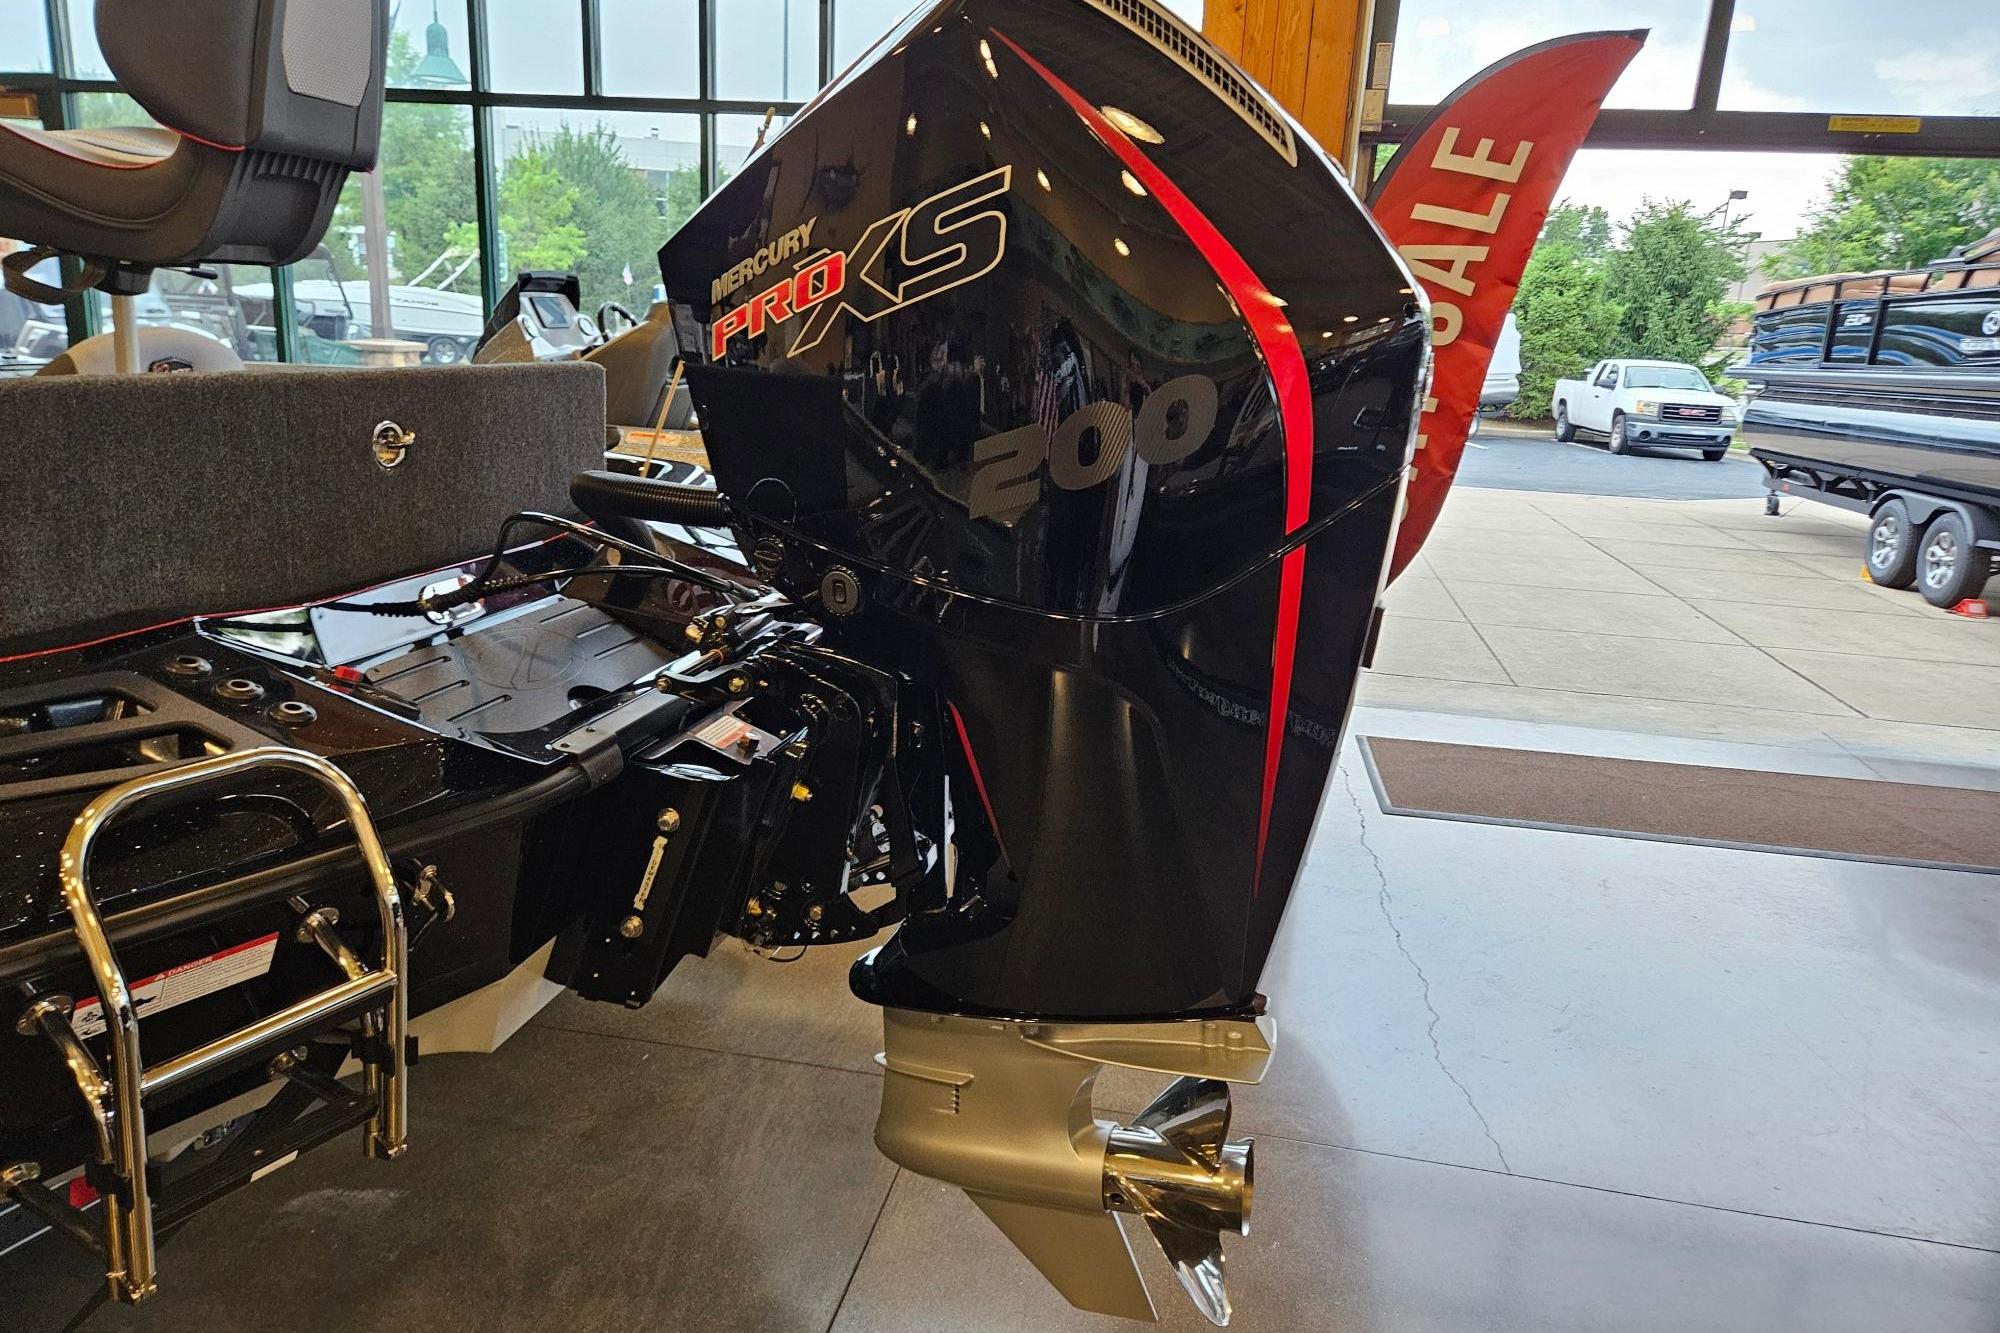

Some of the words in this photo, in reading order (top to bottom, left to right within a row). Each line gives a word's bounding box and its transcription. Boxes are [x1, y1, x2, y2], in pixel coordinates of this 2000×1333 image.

[711, 216, 818, 304] MERCURY
[711, 251, 846, 361] PRO
[787, 165, 1012, 359] XS
[969, 373, 1219, 520] 200
[168, 956, 214, 976] DANGER
